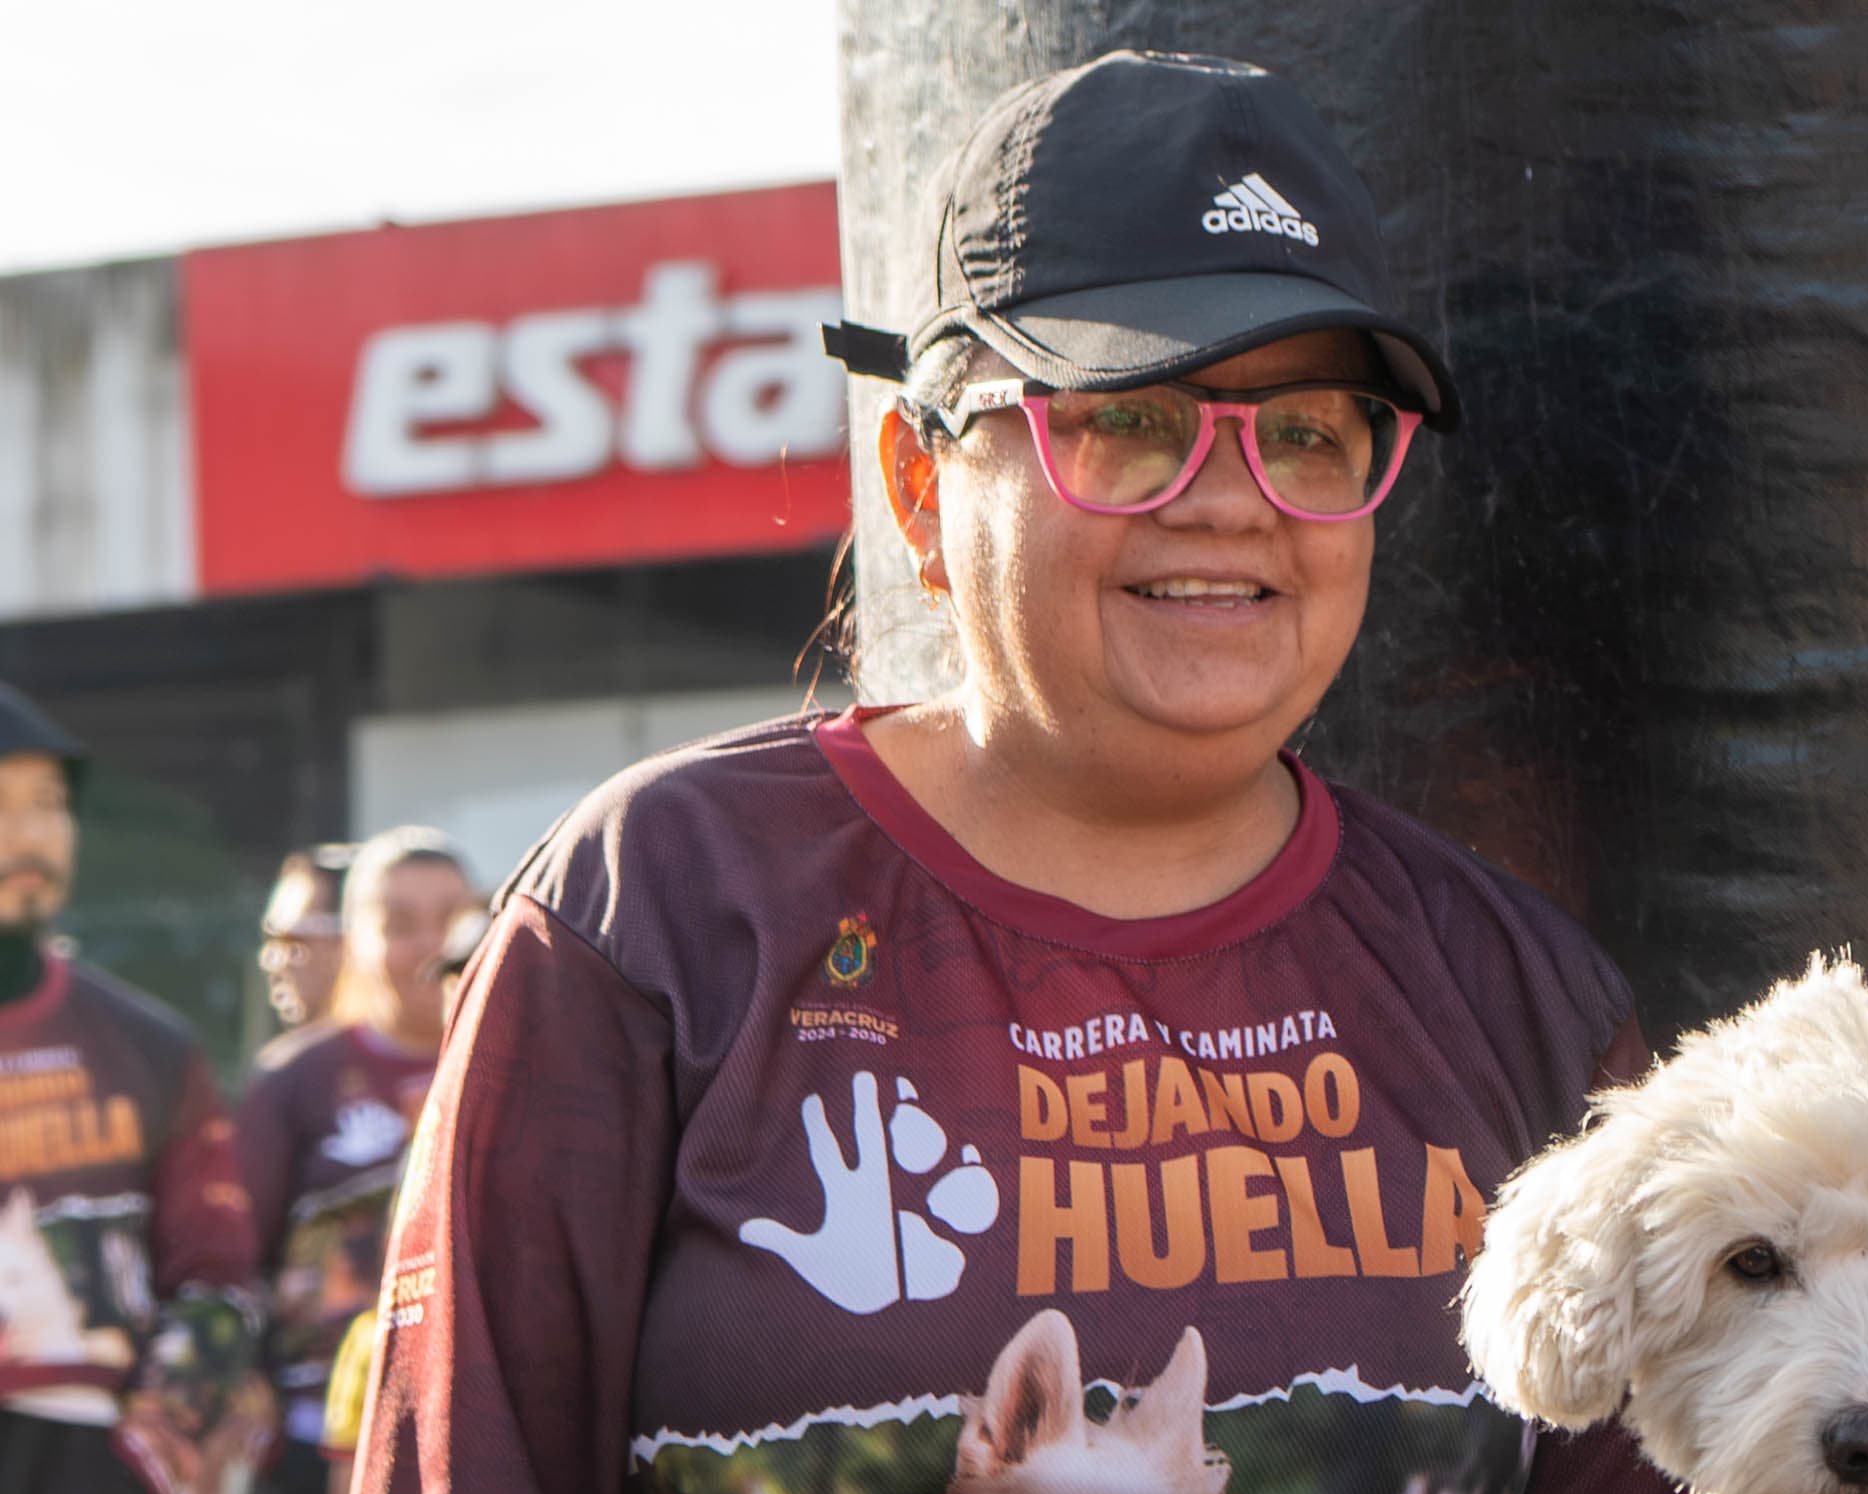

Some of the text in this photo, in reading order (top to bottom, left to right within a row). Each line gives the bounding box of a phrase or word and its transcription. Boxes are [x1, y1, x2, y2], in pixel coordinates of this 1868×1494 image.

[1201, 206, 1320, 247] adidas
[341, 260, 848, 497] esta
[790, 1007, 899, 1039] VERACRUZ
[1008, 1013, 1149, 1060] CARRERA
[1179, 1010, 1337, 1060] CAMINATA
[1018, 1052, 1360, 1150] DEJANDO
[1017, 1142, 1487, 1296] HUELLA
